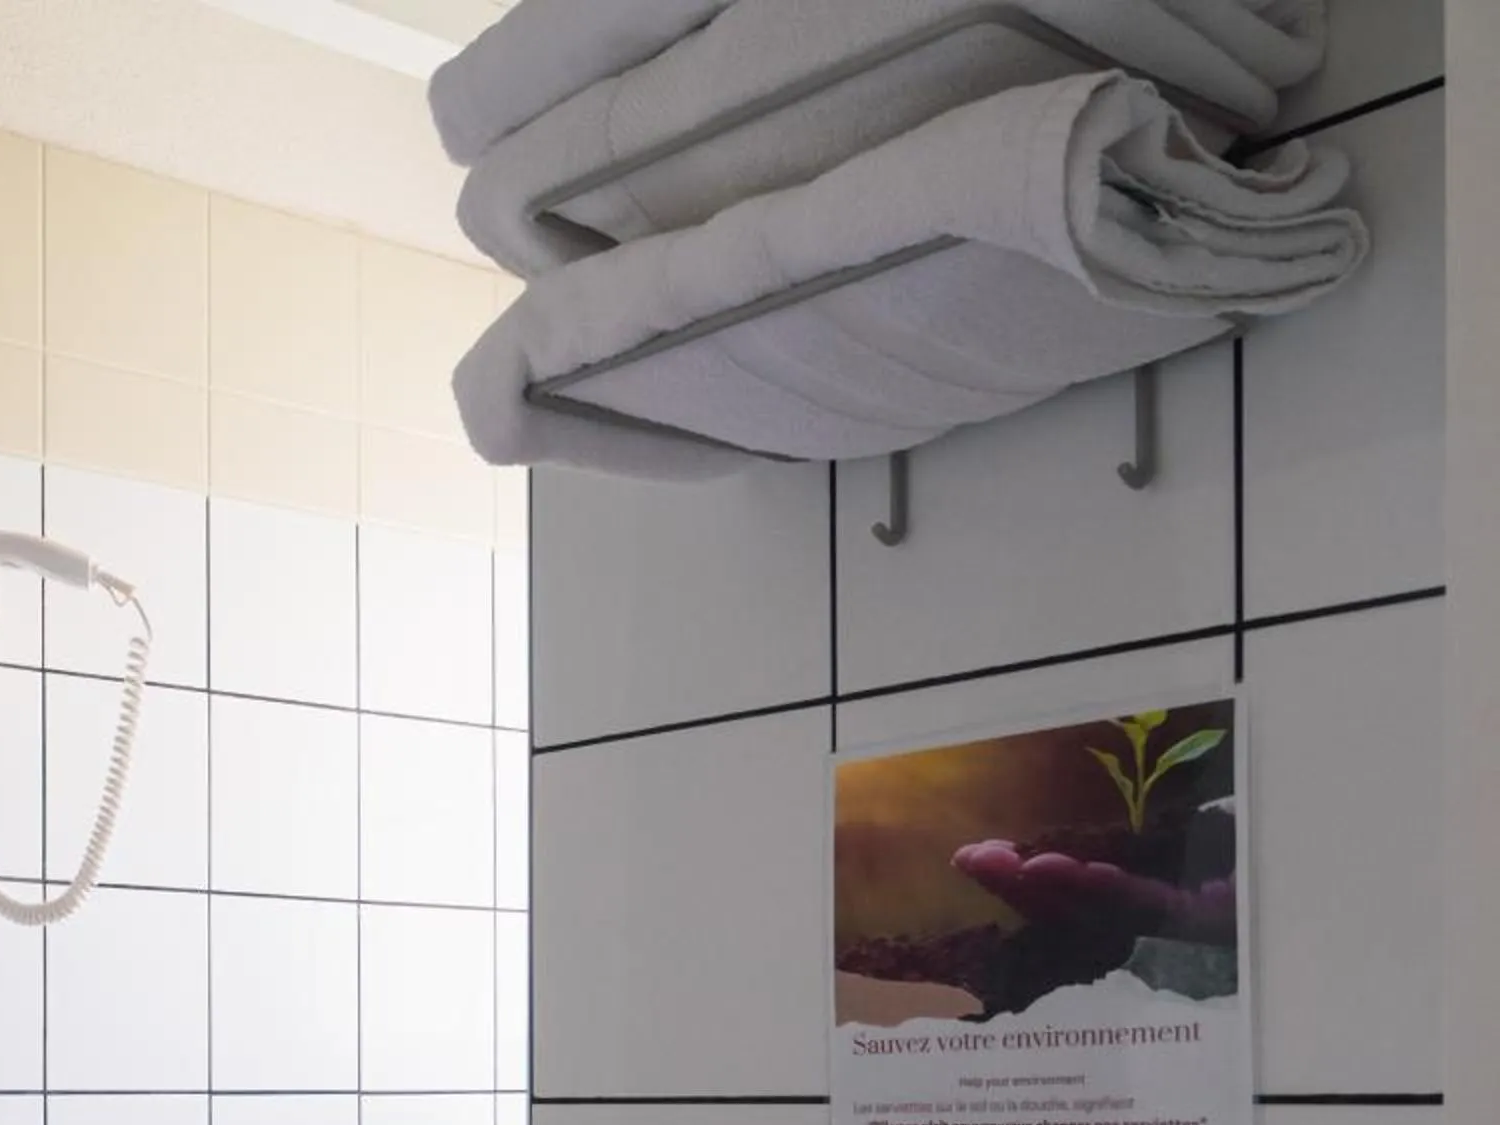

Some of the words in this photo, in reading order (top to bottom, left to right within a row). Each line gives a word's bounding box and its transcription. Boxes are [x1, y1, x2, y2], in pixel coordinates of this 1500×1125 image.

[852, 1032, 931, 1056] Sauvez
[936, 1032, 996, 1053] votre
[1002, 1022, 1201, 1050] environnement
[959, 1077, 982, 1089] Help
[986, 1077, 1009, 1090] your
[1011, 1074, 1085, 1086] environment
